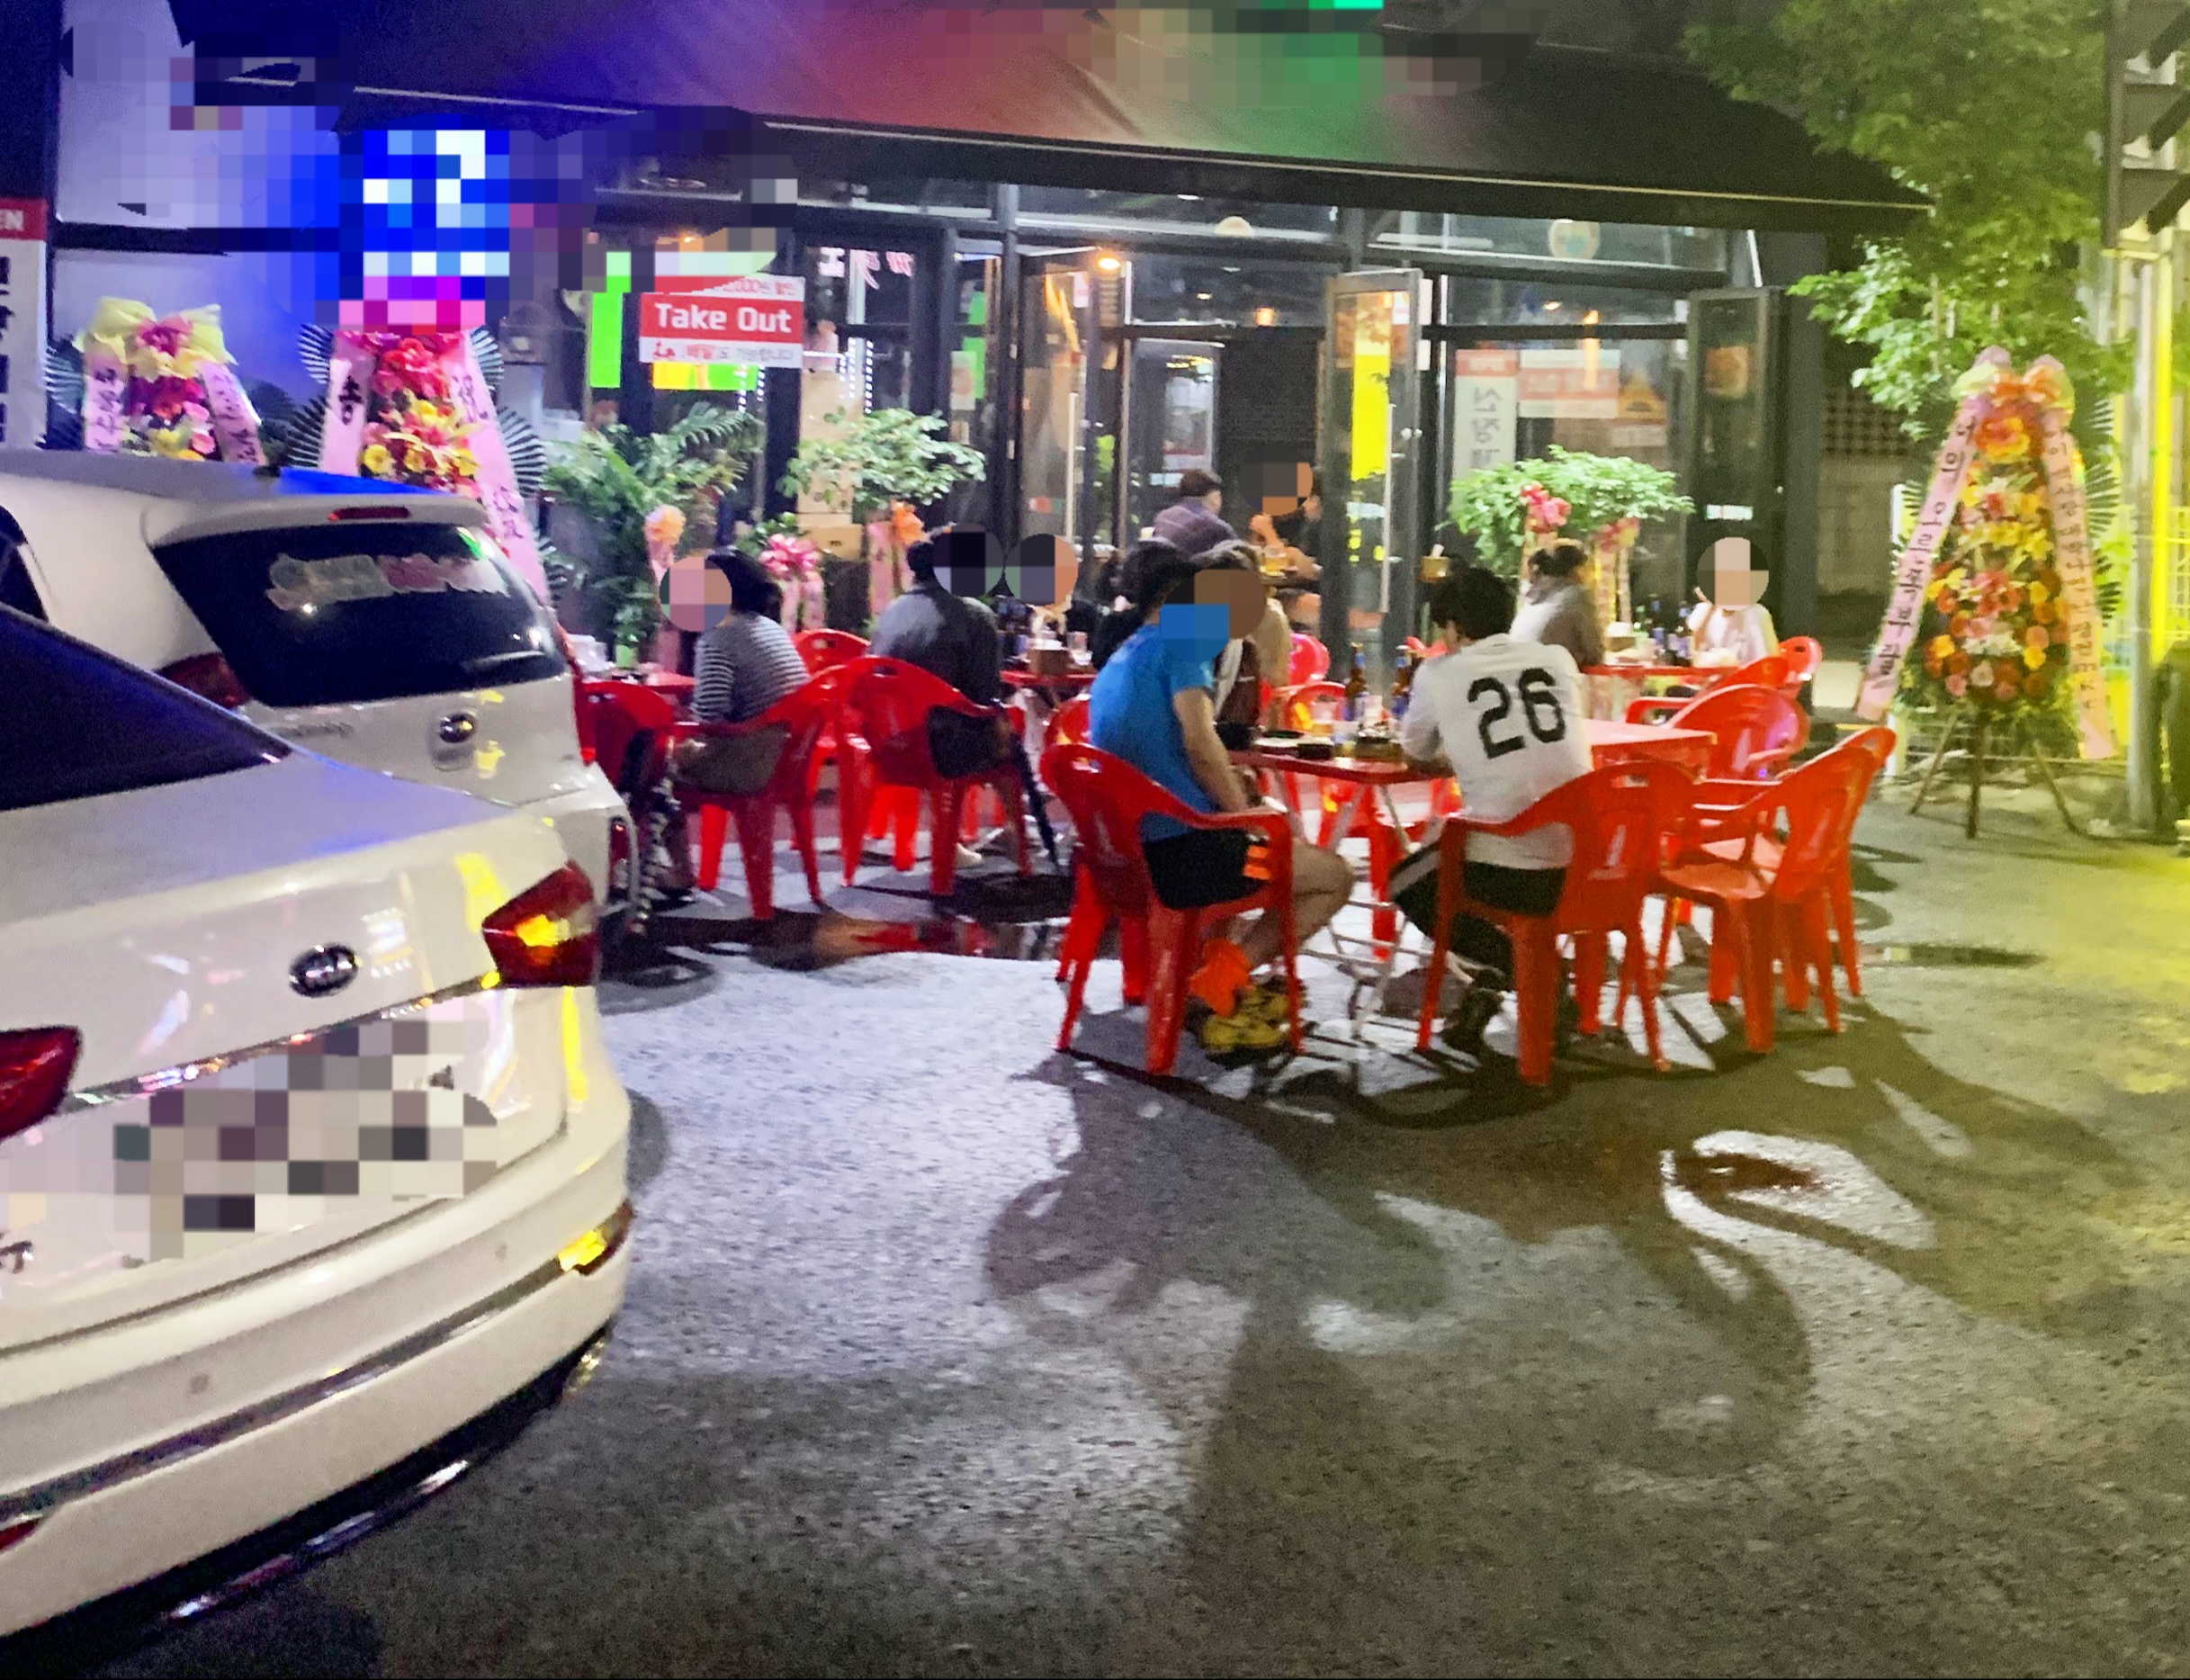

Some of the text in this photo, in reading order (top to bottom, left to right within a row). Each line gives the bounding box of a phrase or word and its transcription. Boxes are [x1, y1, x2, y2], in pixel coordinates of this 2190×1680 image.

[654, 302, 793, 334] Take Out
[1467, 667, 1566, 759] 26
